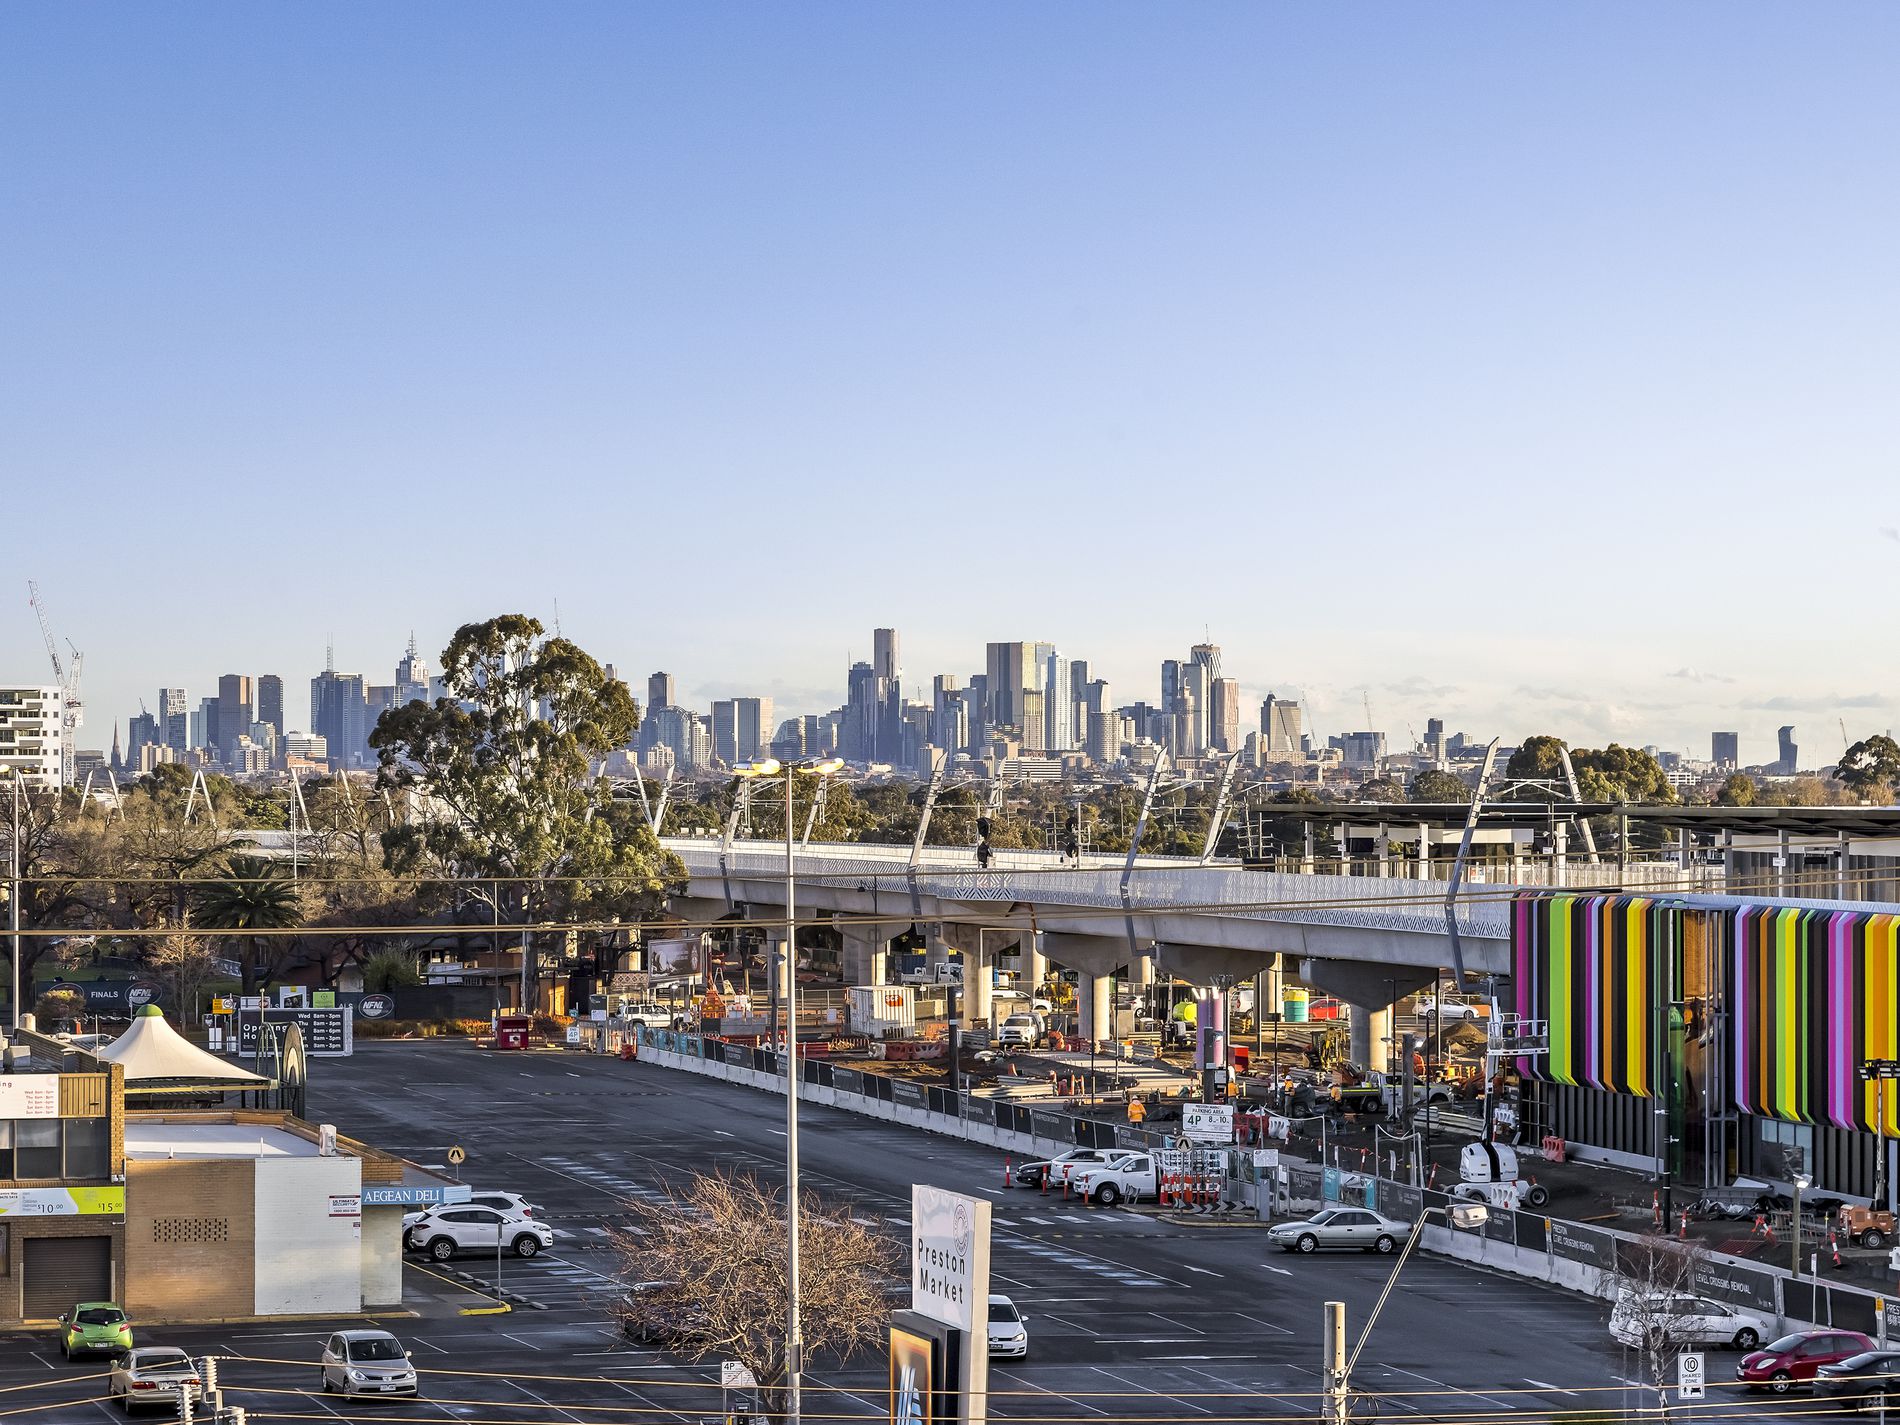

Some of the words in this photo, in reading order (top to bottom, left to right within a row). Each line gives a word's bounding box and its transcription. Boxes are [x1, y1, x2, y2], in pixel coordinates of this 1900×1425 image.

[129, 988, 152, 997] NFNL
[363, 1001, 384, 1009] NFNL
[243, 1024, 288, 1033] Opng
[1187, 1115, 1201, 1125] 4P
[364, 1191, 411, 1202] AEGEAN
[415, 1190, 439, 1201] DELI
[918, 1238, 965, 1275] Preston
[920, 1268, 963, 1304] Market
[1695, 1273, 1709, 1285] LEVEL
[1710, 1276, 1730, 1290] CROSSING
[1730, 1281, 1751, 1295] REMOVAL
[723, 1362, 735, 1370] 4P
[1687, 1360, 1696, 1370] 10
